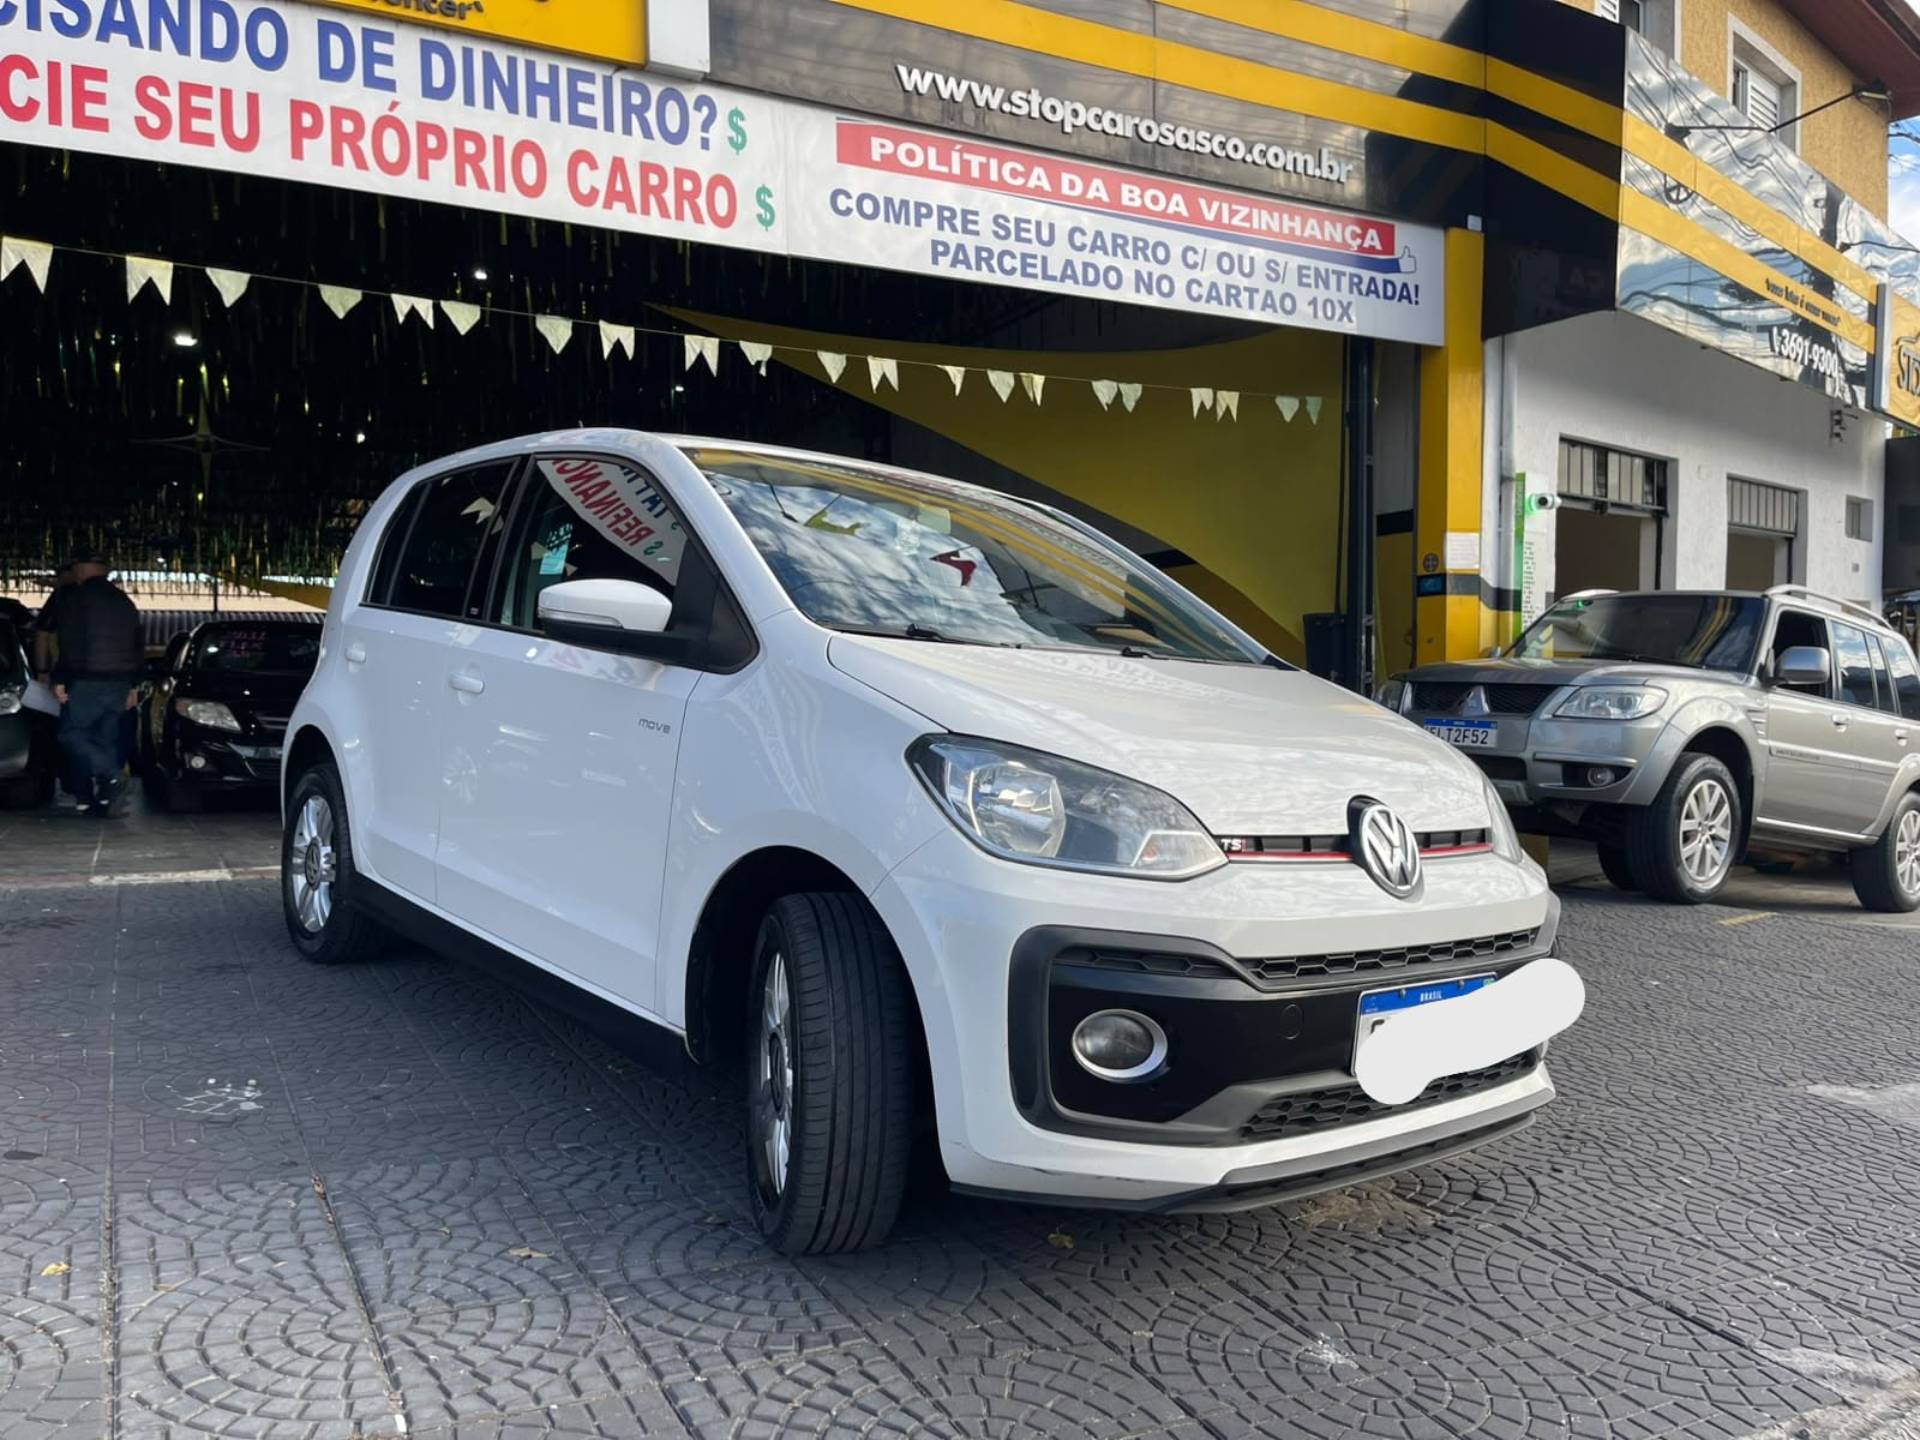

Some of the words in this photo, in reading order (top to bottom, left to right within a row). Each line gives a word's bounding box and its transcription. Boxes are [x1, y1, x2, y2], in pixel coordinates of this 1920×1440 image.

[317, 20, 397, 92] DE
[419, 40, 717, 151] DINHEIRO?
[895, 64, 1354, 184] www.stopcarosasco.com.br
[134, 75, 261, 153] SEU
[290, 99, 548, 199] PRÓPRIO
[567, 149, 738, 229] CARRO
[870, 136, 1053, 192] POLÍTICA
[1061, 171, 1110, 203] DA
[1120, 184, 1189, 218] BOA
[1199, 198, 1383, 251] VIZINHANÇA
[829, 188, 981, 237] COMPRE
[992, 213, 1055, 247] SEU
[1068, 225, 1171, 266] CARRO
[1181, 242, 1208, 272] C/
[1216, 248, 1256, 280] OU
[1265, 254, 1289, 285] S/
[1297, 264, 1421, 306] ENTRADA!
[930, 238, 1124, 293] PARCELADO
[1133, 268, 1176, 299] NO
[1185, 276, 1298, 317] CARTAO
[1306, 295, 1356, 326] 10X
[1780, 328, 1839, 378] 3691-9300
[638, 718, 671, 734] move
[1420, 990, 1443, 1002] BRASIL
